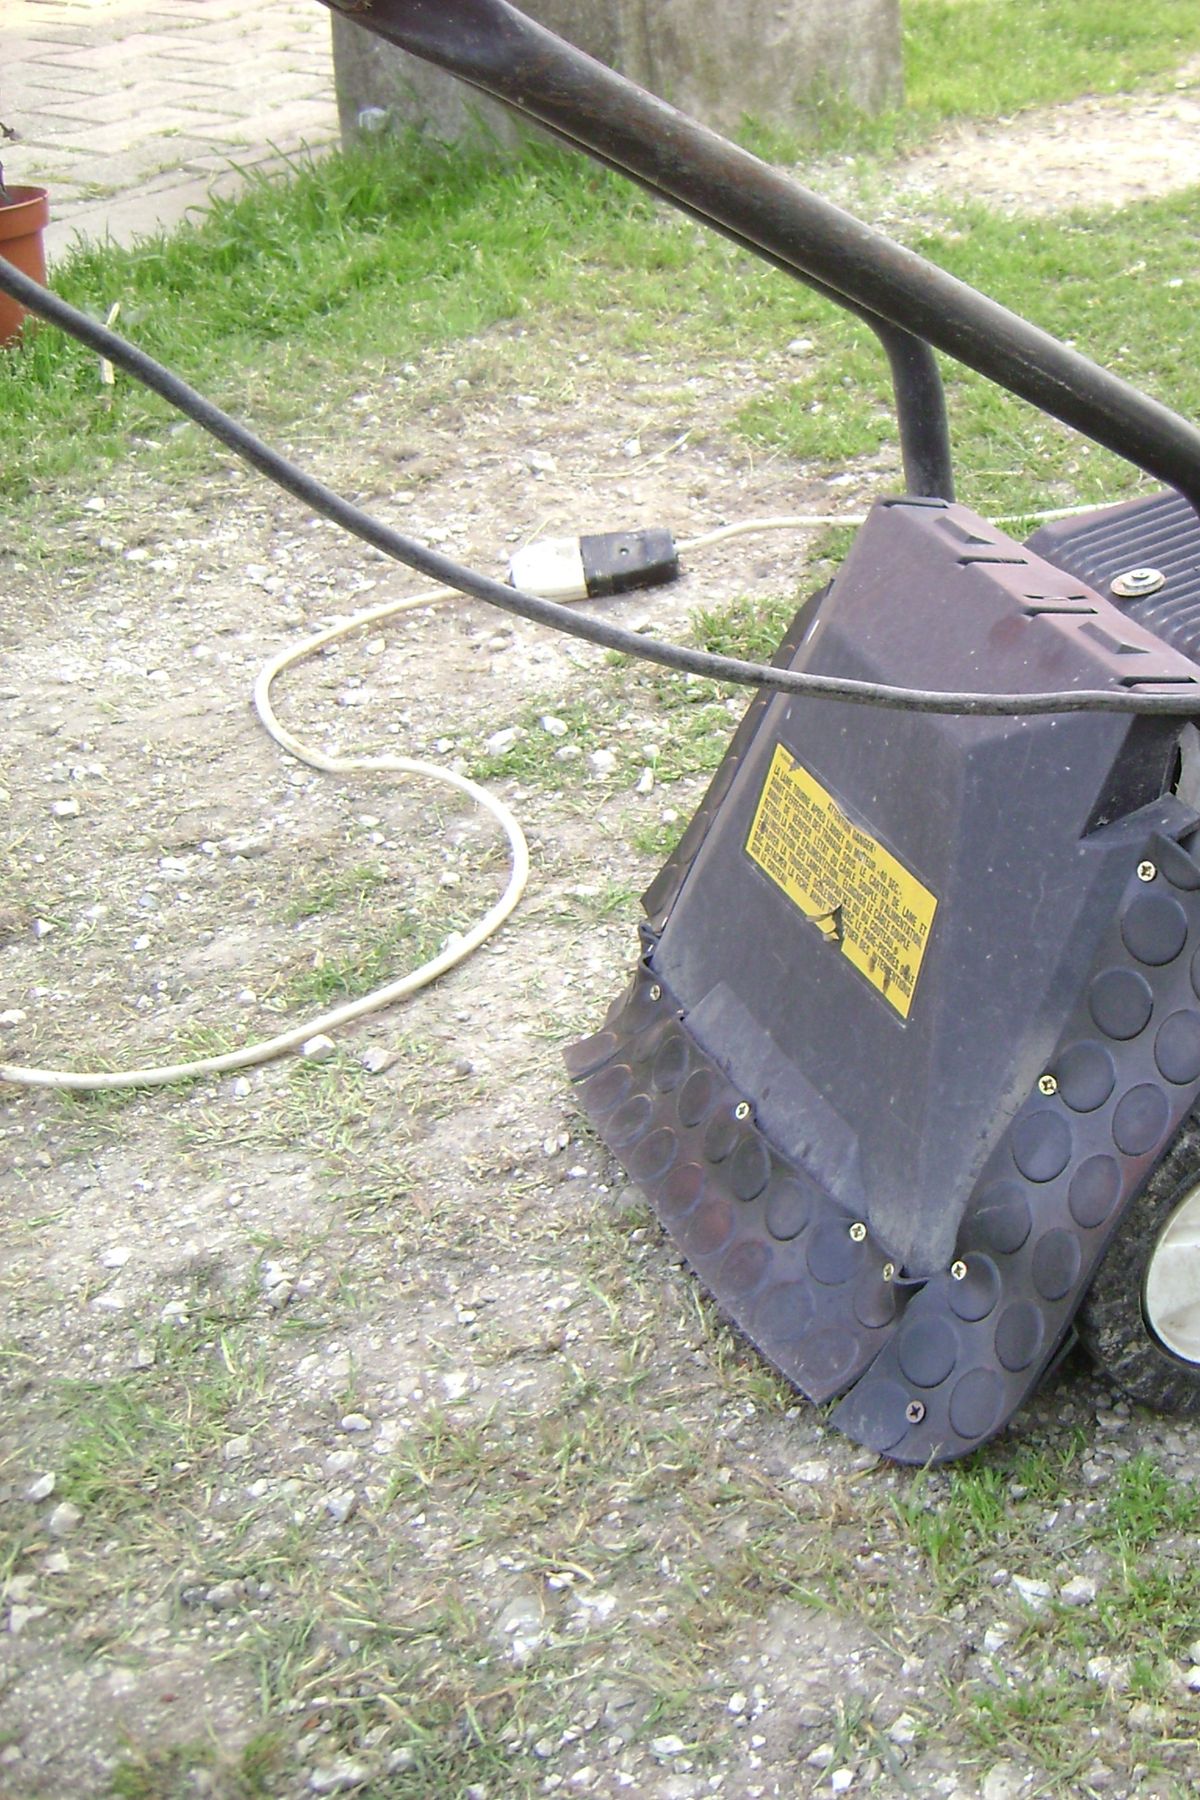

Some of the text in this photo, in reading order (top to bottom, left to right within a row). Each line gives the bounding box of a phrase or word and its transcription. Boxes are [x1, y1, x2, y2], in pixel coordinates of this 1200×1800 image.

[773, 764, 780, 777] LA
[779, 770, 793, 789] LAME
[760, 851, 767, 864] LE
[782, 802, 790, 816] DE
[829, 852, 839, 868] DU
[837, 859, 856, 885] CABLE
[857, 876, 878, 904] SOUPLE
[787, 864, 795, 879] LA
[795, 844, 806, 862] DES
[811, 817, 822, 834] DES
[859, 863, 867, 879] LE
[868, 871, 890, 901] CARTER
[891, 894, 900, 911] DE
[901, 904, 917, 928] LAME
[918, 921, 927, 938] ET
[779, 842, 787, 857] LA
[854, 918, 862, 932] LE
[780, 814, 787, 828] LA
[865, 900, 874, 915] LE
[872, 907, 891, 932] CABLE
[889, 923, 911, 952] SOUPLE
